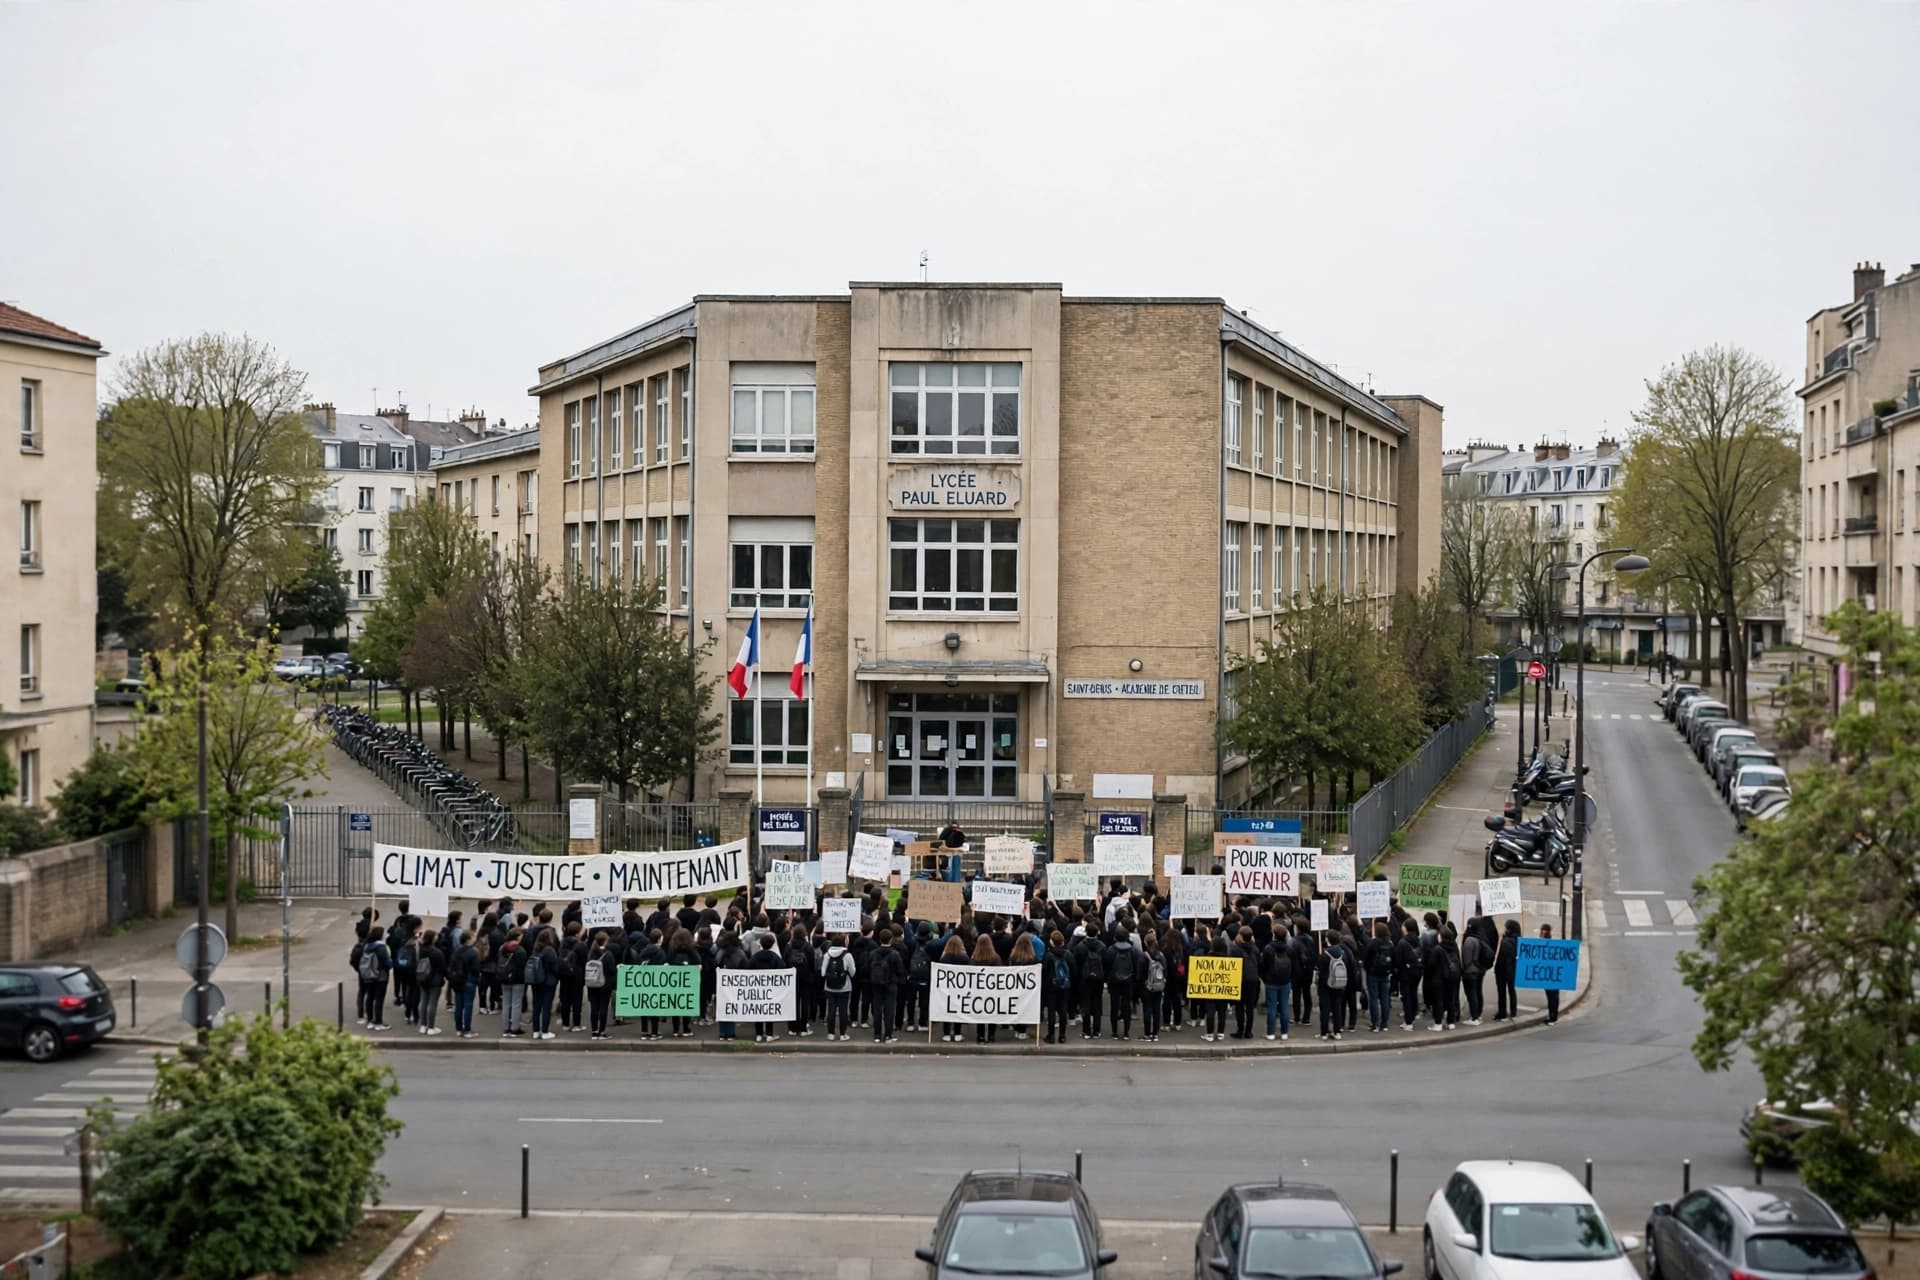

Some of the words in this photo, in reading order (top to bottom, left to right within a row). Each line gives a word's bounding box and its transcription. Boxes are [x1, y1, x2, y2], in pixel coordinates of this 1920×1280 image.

[931, 470, 976, 488] LYCÉE
[902, 491, 939, 505] PAUL
[947, 491, 1007, 505] ELUARD
[1231, 849, 1267, 867] POUR
[1273, 851, 1317, 870] NOTRE
[382, 852, 470, 889] CLIMAT
[487, 859, 585, 891] JUSTICE
[609, 849, 742, 892] MAINTENANT
[1229, 870, 1291, 891] AVENIR
[625, 966, 691, 988] ÉCOLOGIE
[721, 974, 794, 987] ENSEIGNEMENT
[936, 968, 1036, 990] PROTÉGEONS
[631, 993, 695, 1010] URGENCE
[737, 989, 773, 1001] PUBLIC
[946, 991, 1019, 1015] L'ÉCOLE
[725, 1003, 738, 1015] EN
[742, 1003, 782, 1015] DANGER
